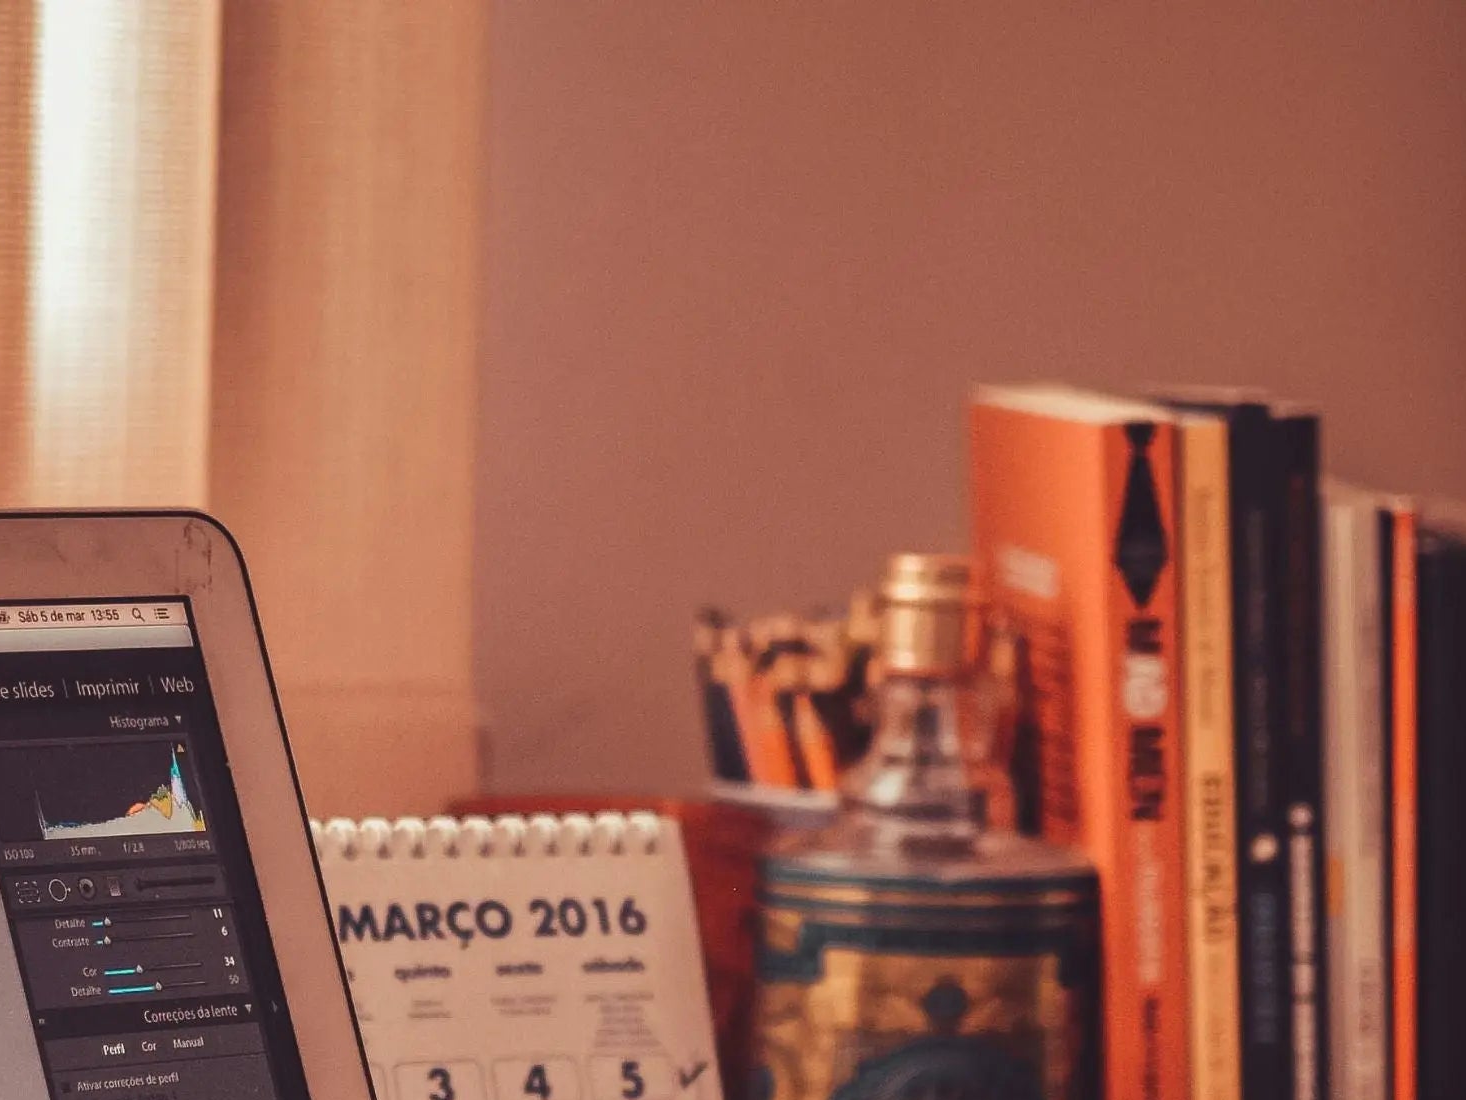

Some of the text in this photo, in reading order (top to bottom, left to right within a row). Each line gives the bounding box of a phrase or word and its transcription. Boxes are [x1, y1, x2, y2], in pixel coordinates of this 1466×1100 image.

[18, 609, 38, 623] Sáb
[41, 611, 48, 622] 5
[51, 610, 63, 622] de
[66, 610, 85, 622] mar
[90, 608, 120, 621] 13:55
[14, 680, 56, 699] slides
[76, 678, 141, 699] Imprimir
[160, 676, 195, 693] Web
[109, 715, 170, 729] Histograma
[55, 918, 86, 930] Detalhe
[221, 926, 229, 936] 6
[338, 897, 648, 950] MARÇO 2016
[83, 956, 235, 978] Cor 34
[70, 985, 102, 998] Detalhe
[144, 1004, 238, 1025] Correções da lente
[103, 1036, 205, 1056] Perfil Cor Manual
[104, 1075, 144, 1090] correções
[146, 1074, 157, 1085] de
[158, 1071, 180, 1087] perfil
[621, 1061, 646, 1100] 5
